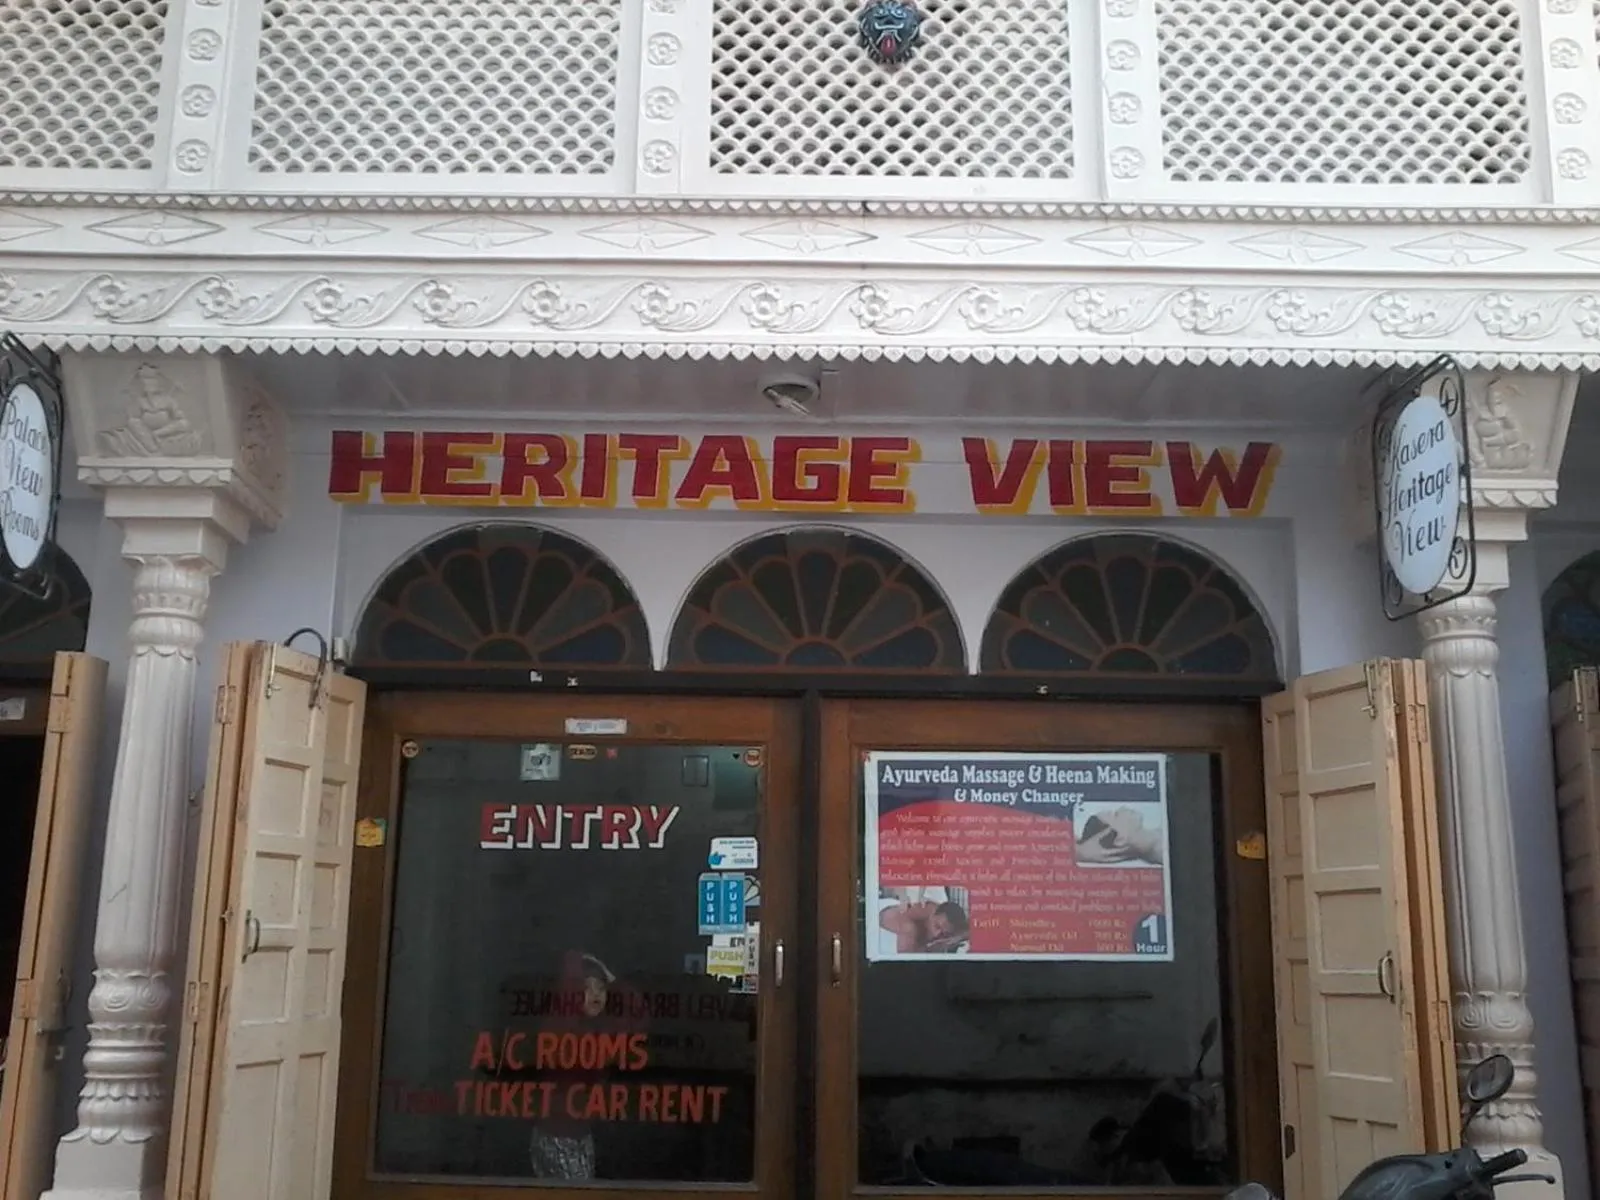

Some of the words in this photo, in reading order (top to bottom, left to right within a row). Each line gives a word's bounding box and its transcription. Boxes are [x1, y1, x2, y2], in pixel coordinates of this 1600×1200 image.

[328, 430, 920, 512] HERITAGE
[961, 436, 1282, 517] VIEW
[1385, 420, 1445, 485] Kasera
[1384, 463, 1452, 529] Heritage
[1392, 509, 1446, 564] View
[882, 765, 958, 786] Ayurveda
[963, 765, 1025, 788] Massage
[1028, 764, 1043, 785] &
[1048, 765, 1092, 785] Heena
[1097, 766, 1155, 788] Making
[954, 788, 967, 802] &
[970, 789, 1017, 805] Money
[1022, 790, 1084, 805] Changer
[480, 804, 680, 850] ENTRY
[706, 881, 716, 924] PUSH
[729, 881, 738, 924] PUSH
[1136, 943, 1167, 953] Hour
[1140, 914, 1160, 943] 1
[710, 950, 744, 962] PUSH
[470, 1029, 527, 1079] A/C
[536, 1032, 649, 1071] ROOMS
[455, 1080, 557, 1119] TICKET
[566, 1083, 629, 1122] CAR
[638, 1085, 728, 1124] RENT
